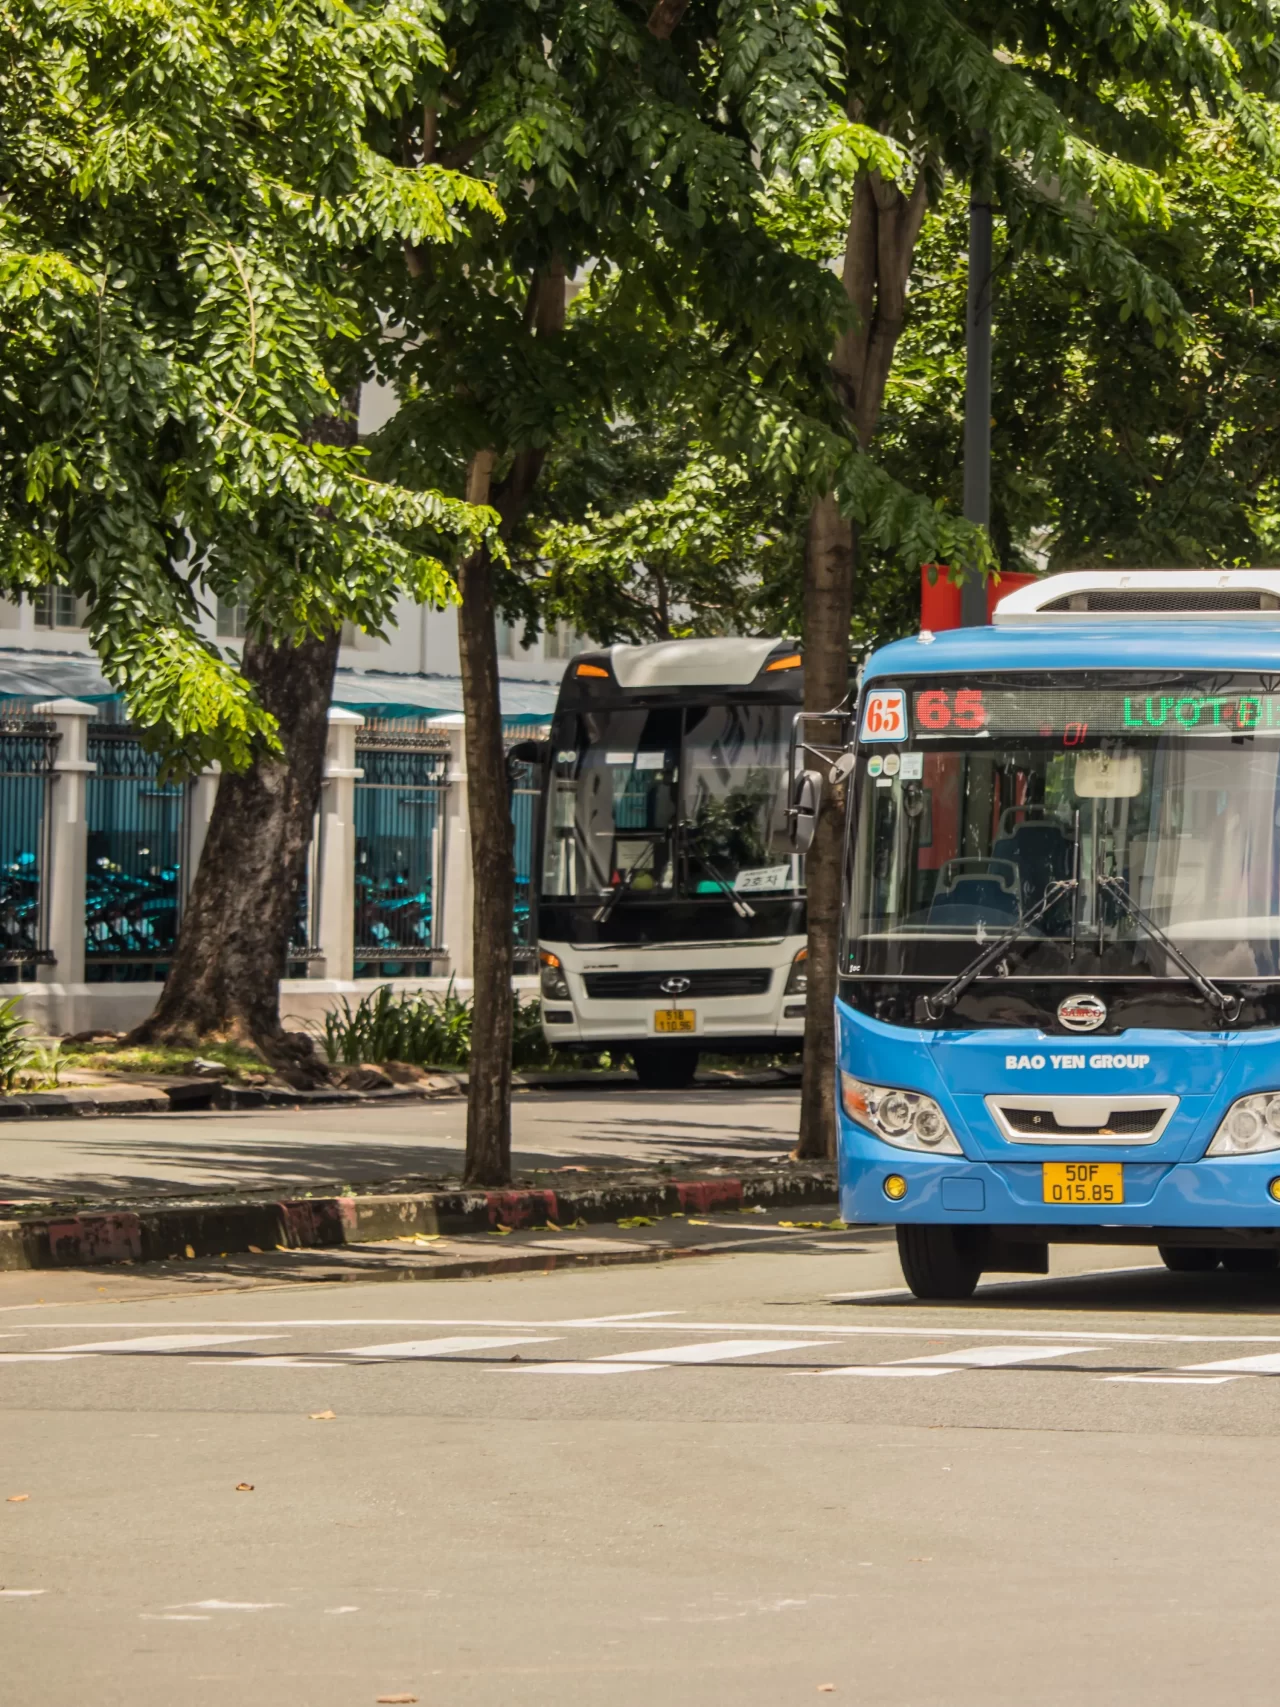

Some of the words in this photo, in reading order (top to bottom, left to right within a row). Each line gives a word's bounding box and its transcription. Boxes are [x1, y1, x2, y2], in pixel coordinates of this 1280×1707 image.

[866, 698, 902, 733] 65
[916, 690, 986, 729] 65
[1123, 696, 1228, 731] LƯỢT
[1059, 1007, 1105, 1018] SAMCO
[1005, 1054, 1046, 1070] BAO
[1050, 1054, 1086, 1069] YEN
[1089, 1054, 1150, 1069] GROUP
[1065, 1164, 1099, 1182] 50F
[1052, 1184, 1114, 1201] 015.85
